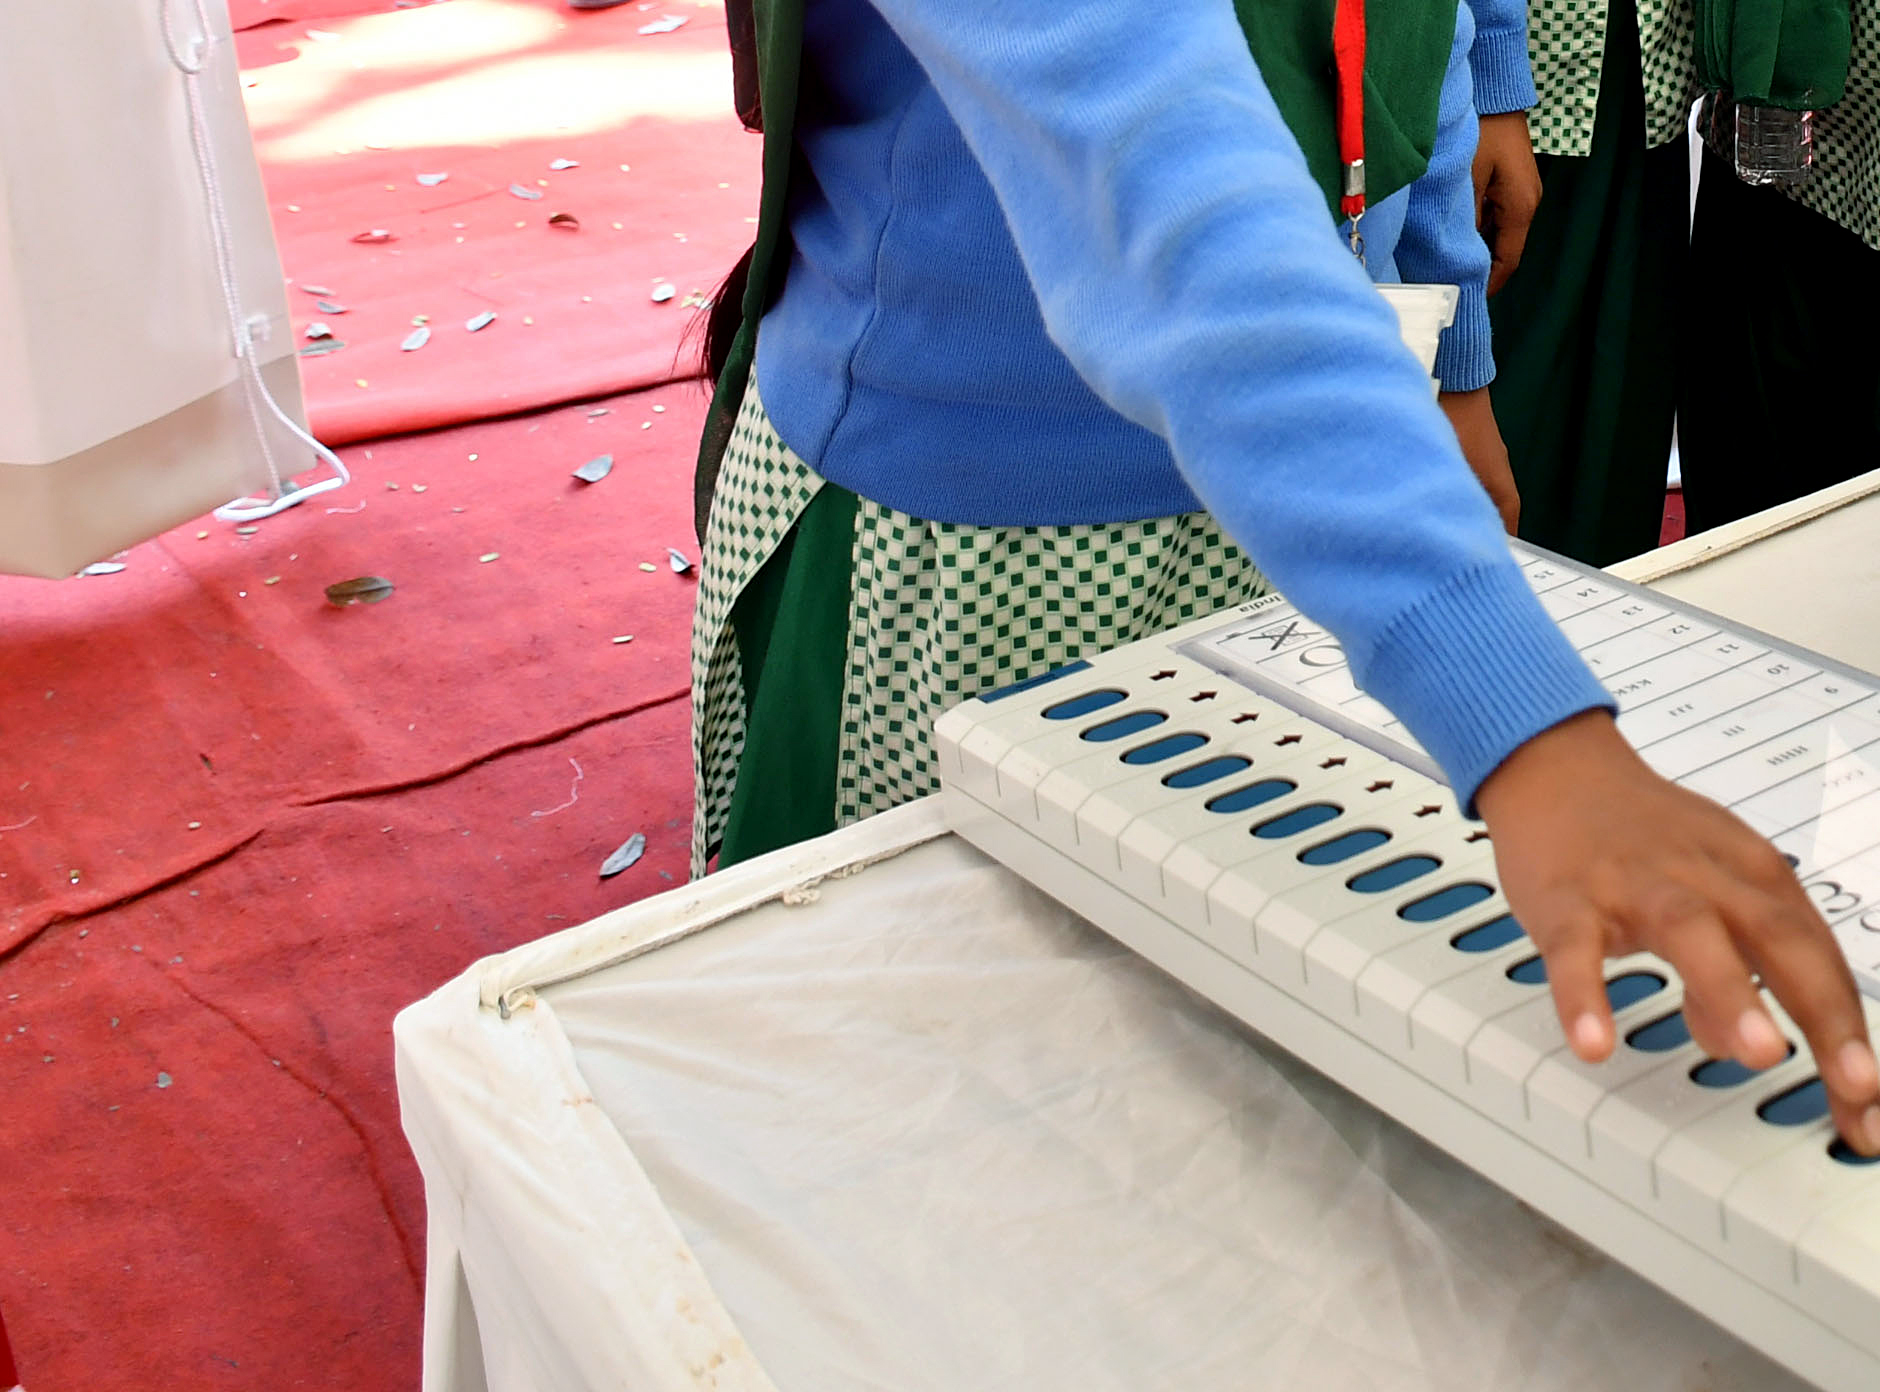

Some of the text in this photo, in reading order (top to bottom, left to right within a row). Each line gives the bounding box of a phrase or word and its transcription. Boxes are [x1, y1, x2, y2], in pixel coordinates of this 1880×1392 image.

[1532, 569, 1555, 580] 15
[1576, 586, 1598, 599] 14
[1239, 595, 1281, 613] India
[1622, 605, 1643, 616] 13
[1670, 623, 1690, 636] 12
[1615, 643, 1740, 697] 11 KKK
[1767, 663, 1790, 676] 10
[1824, 685, 1838, 695] 9
